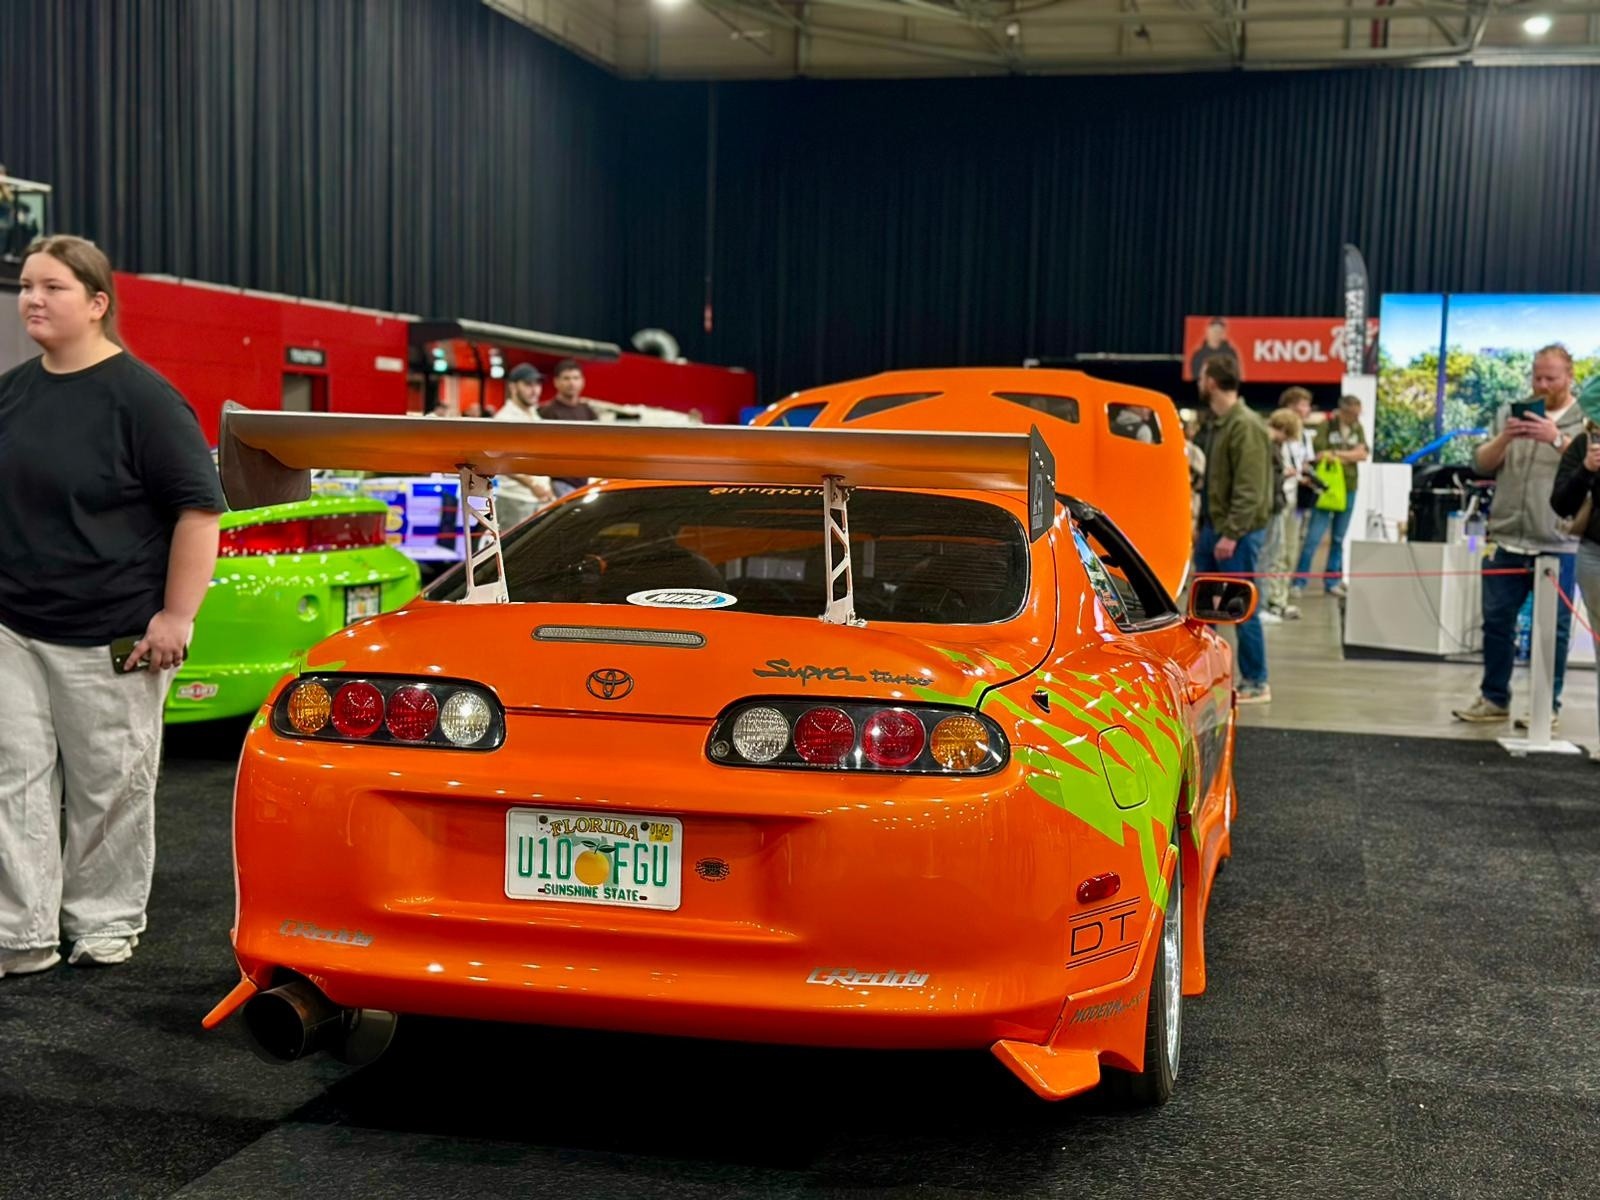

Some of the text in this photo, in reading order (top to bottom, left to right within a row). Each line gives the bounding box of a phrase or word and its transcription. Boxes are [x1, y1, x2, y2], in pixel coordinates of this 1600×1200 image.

[1253, 339, 1328, 363] KNOL
[752, 658, 866, 686] Supra
[550, 816, 640, 842] FLORIDA
[517, 835, 573, 880] U10
[612, 841, 669, 887] FGU
[543, 882, 640, 902] SUNSHINE STATE
